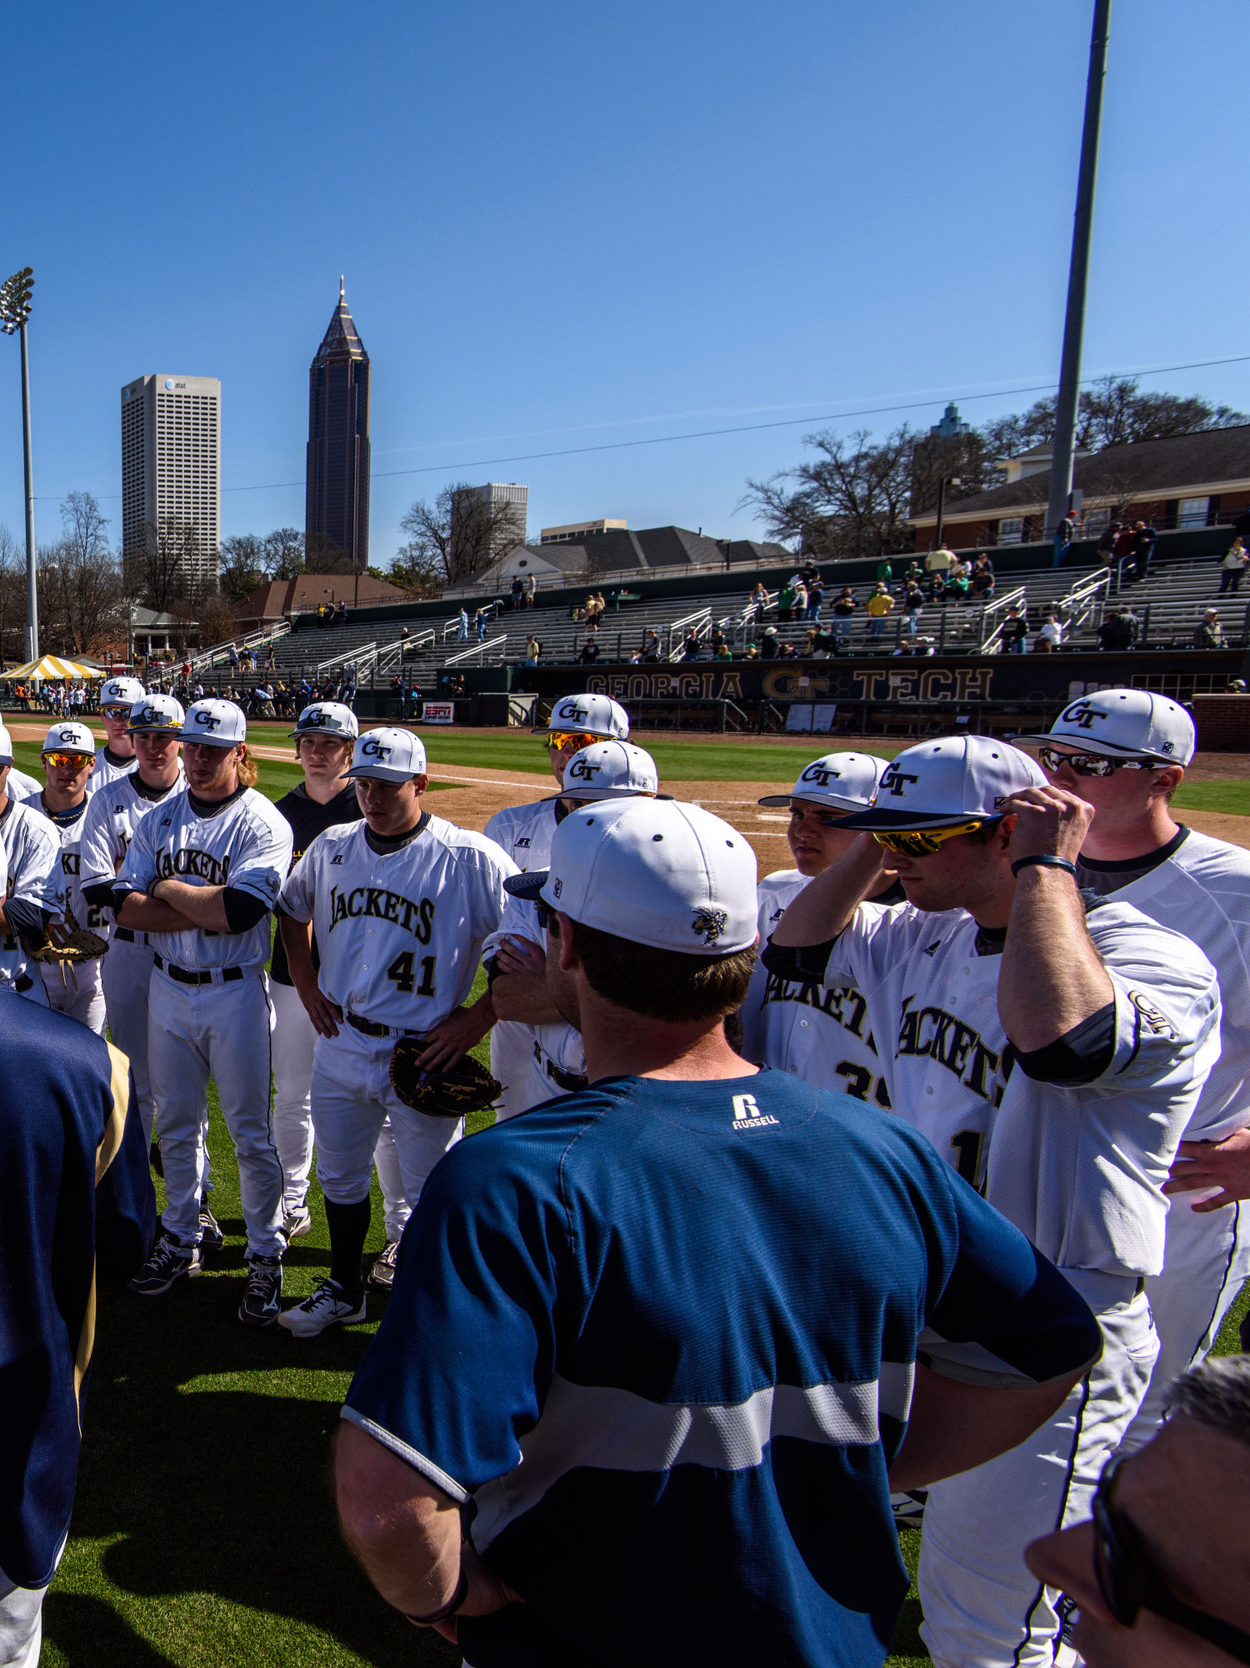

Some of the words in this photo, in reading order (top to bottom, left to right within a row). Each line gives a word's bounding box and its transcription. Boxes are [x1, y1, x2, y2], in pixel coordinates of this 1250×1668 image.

[108, 684, 128, 698] GT
[587, 672, 743, 699] GEORGIA
[854, 669, 994, 700] TECH
[194, 711, 222, 730] GT
[425, 706, 452, 716] ESPN
[558, 704, 589, 723] GT
[1063, 701, 1109, 729] GT
[59, 730, 82, 745] GT
[361, 740, 392, 760] GT
[569, 759, 602, 781] GT
[801, 762, 841, 787] GT
[879, 762, 920, 797] GT
[156, 846, 231, 886] JACKETS
[329, 884, 435, 947] JACKETS
[387, 950, 437, 998] 41
[732, 1094, 761, 1120] R
[732, 1115, 779, 1130] RUSSELL
